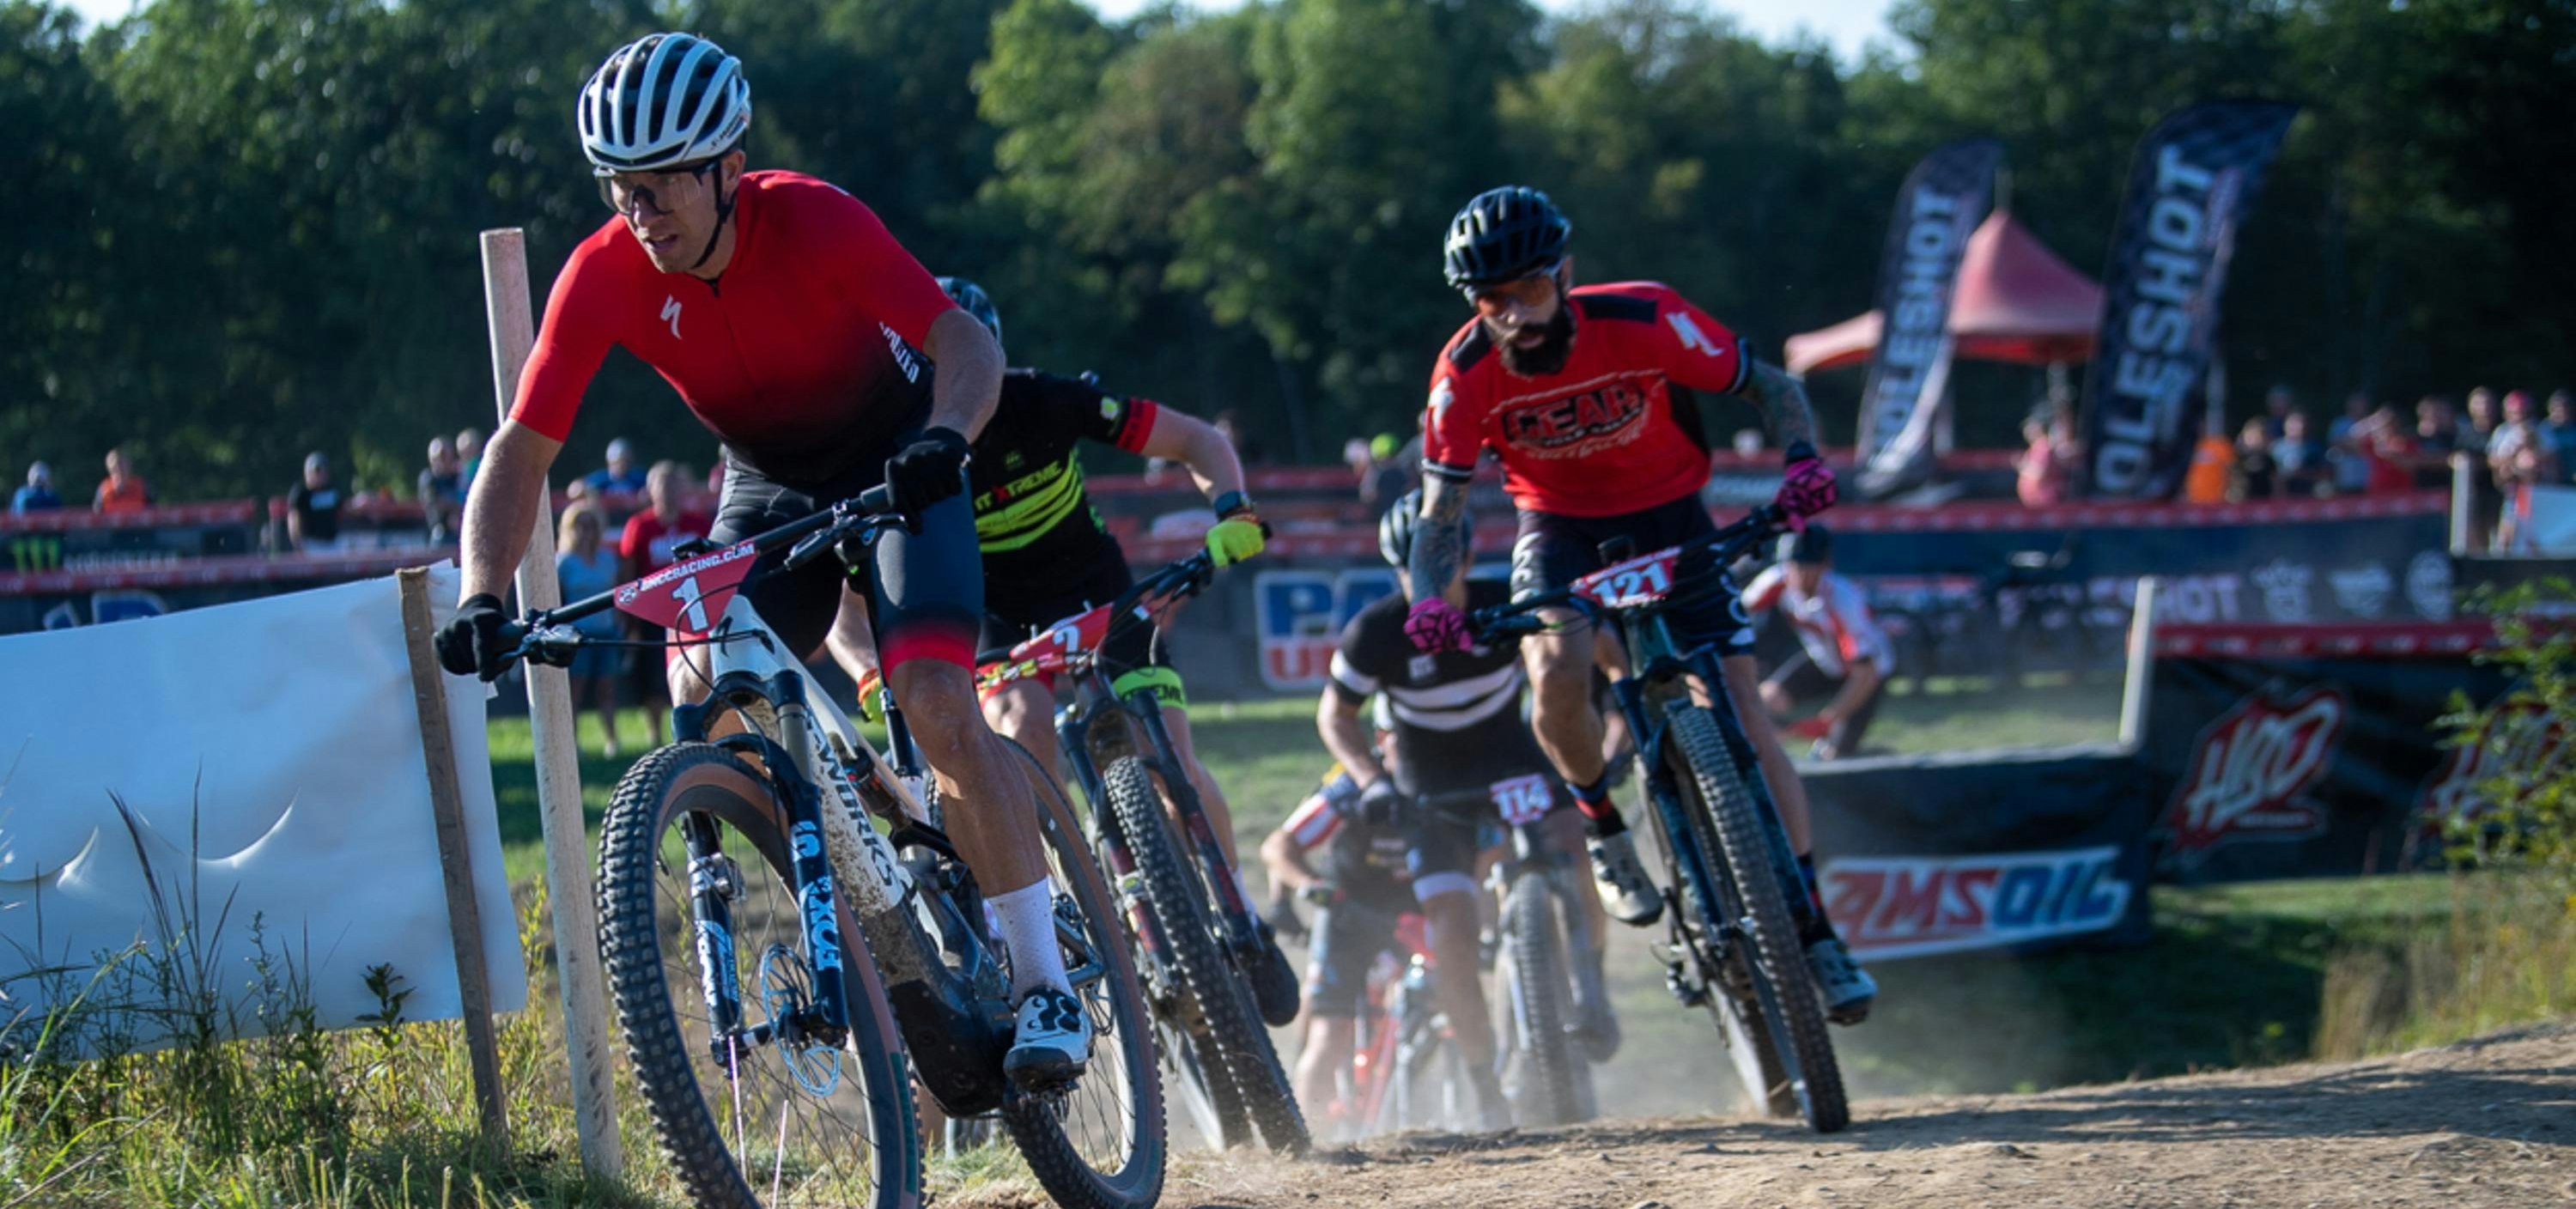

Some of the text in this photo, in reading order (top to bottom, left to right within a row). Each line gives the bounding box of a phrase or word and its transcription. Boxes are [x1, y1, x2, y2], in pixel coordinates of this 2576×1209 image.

[2095, 143, 2217, 493] OLESHOT
[671, 574, 710, 634] 1
[1591, 561, 1669, 607] 121
[1052, 624, 1082, 665] 2
[1493, 777, 1552, 821] 114
[809, 895, 844, 973] FOX
[1822, 860, 2128, 950] AMSOIL
